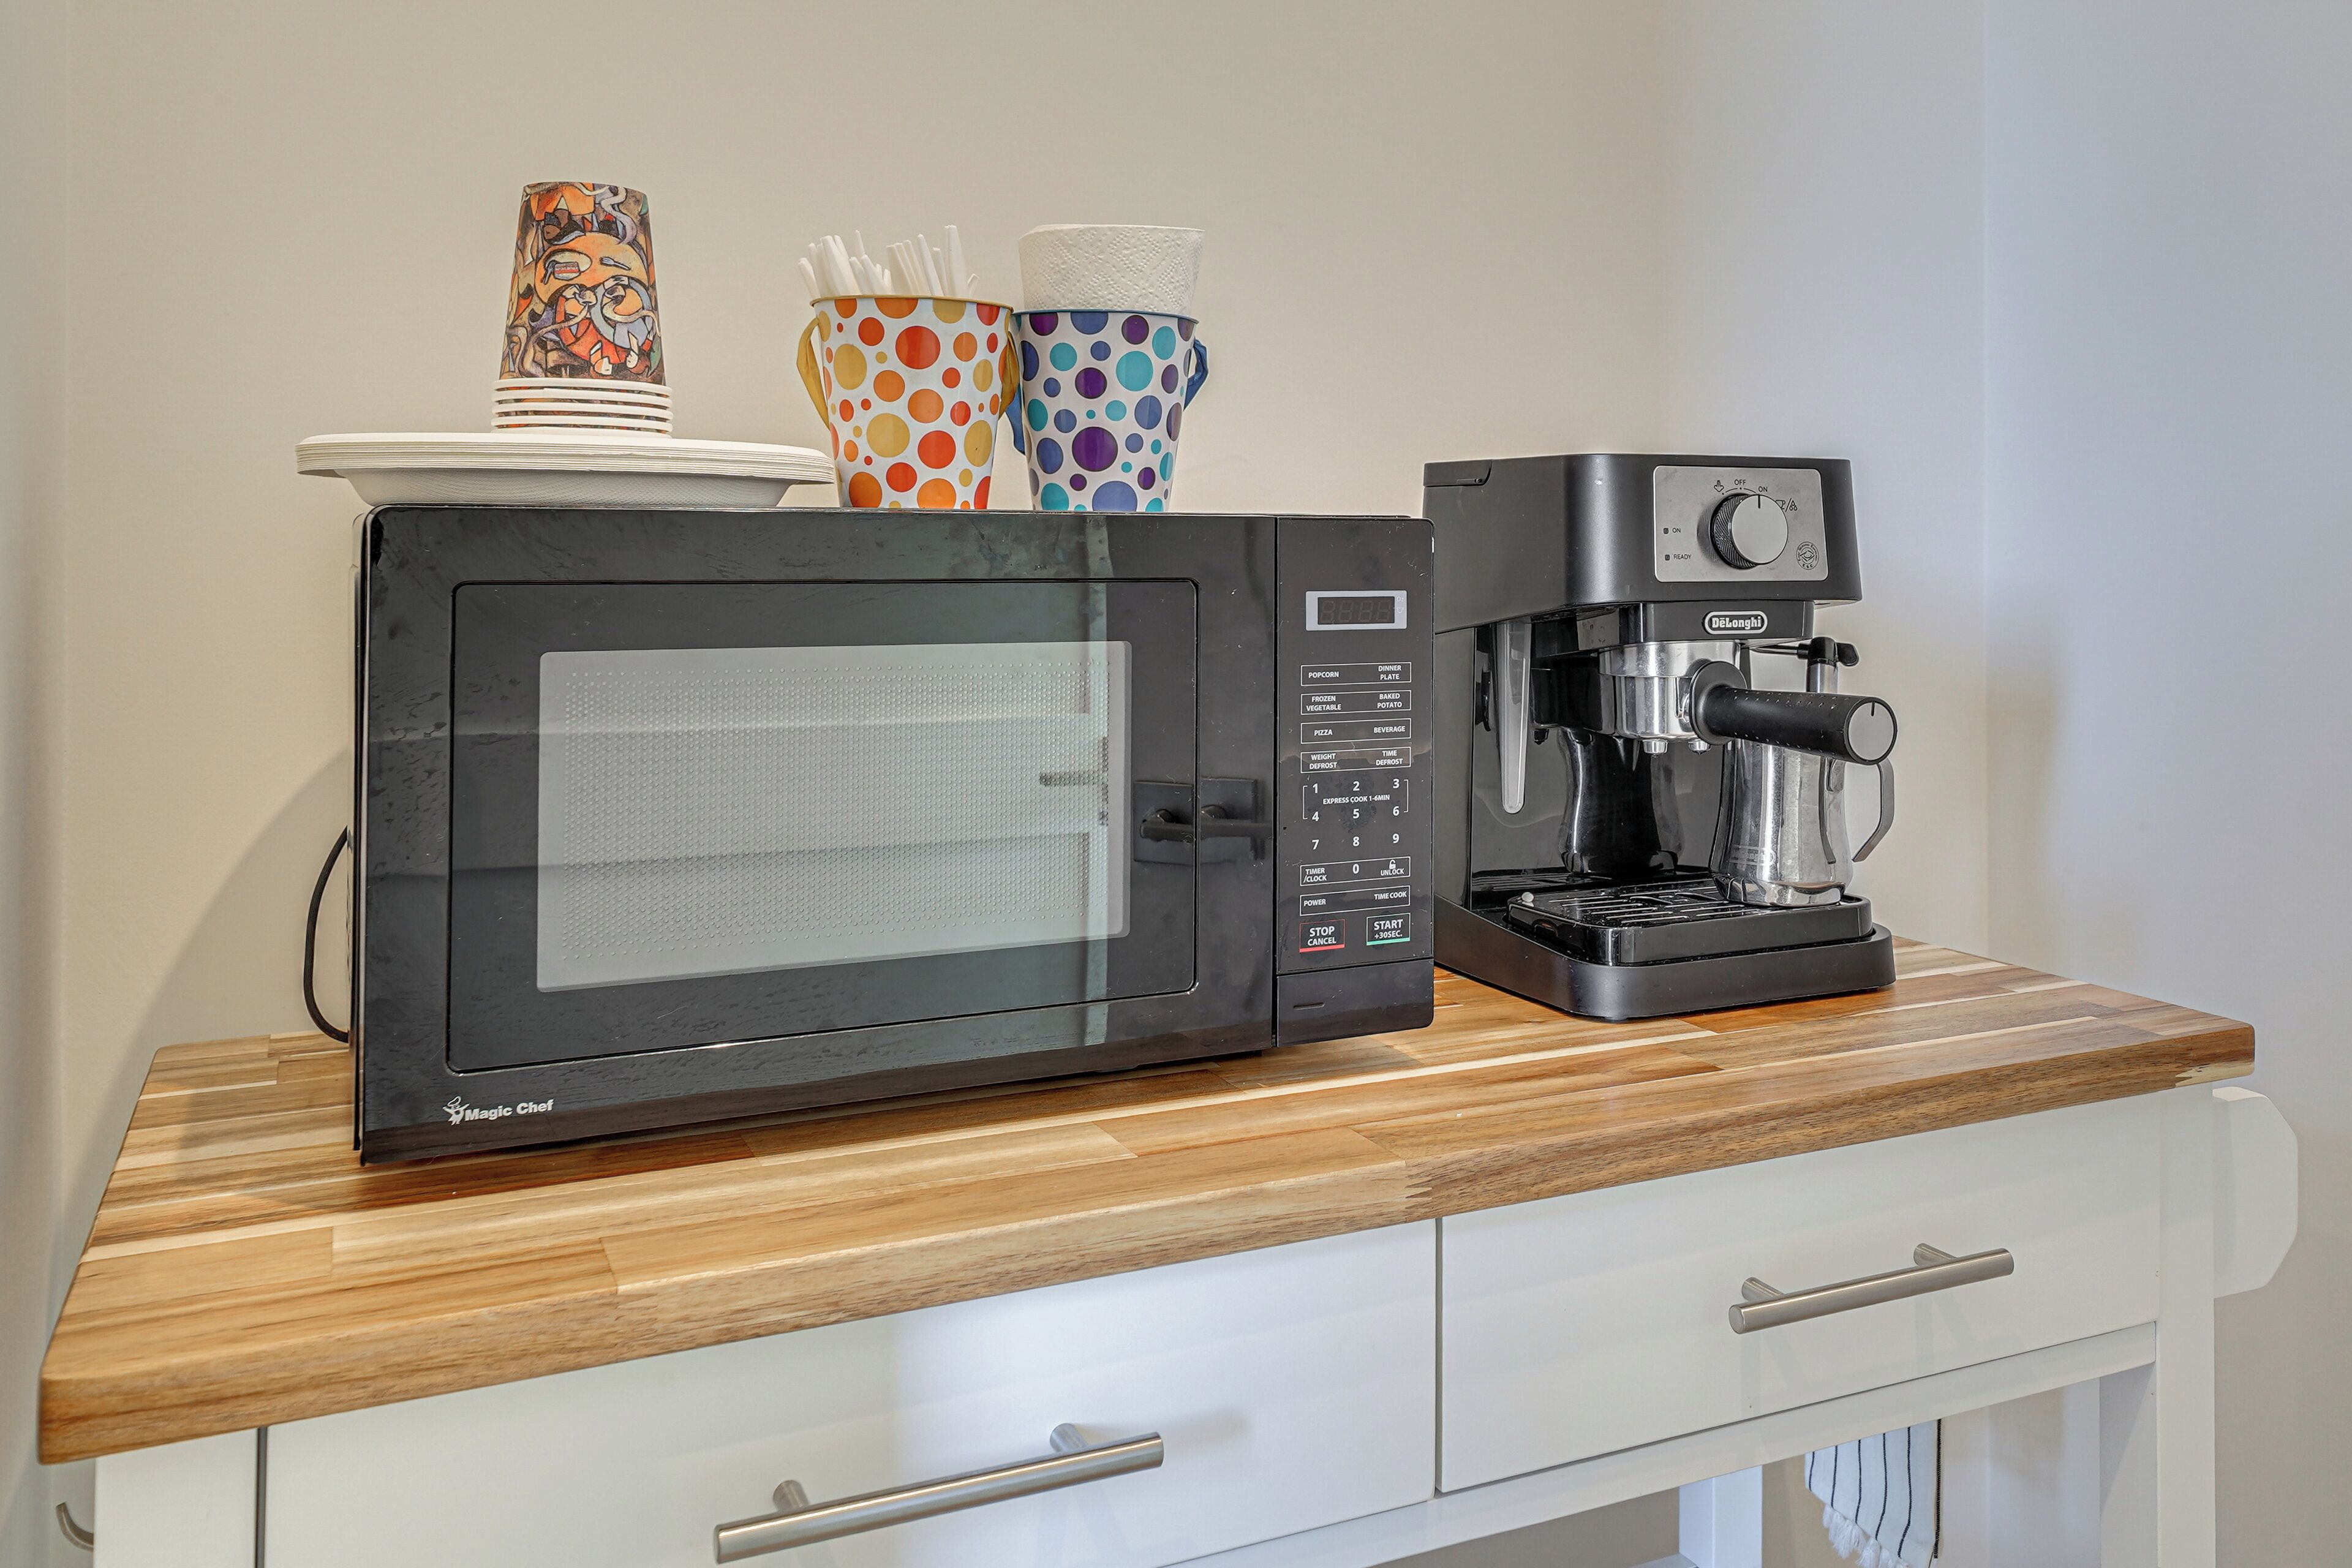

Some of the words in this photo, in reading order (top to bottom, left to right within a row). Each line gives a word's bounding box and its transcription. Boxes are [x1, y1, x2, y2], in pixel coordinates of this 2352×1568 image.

[1309, 761, 1338, 770] DEFROST
[1375, 758, 1403, 766] DEFROST
[1312, 783, 1319, 794] 1
[1352, 781, 1360, 791] 2
[1393, 778, 1400, 789] 3
[1352, 808, 1360, 819] 5
[1393, 805, 1400, 816] 6
[1311, 811, 1319, 822] 4
[1352, 836, 1360, 847] 8
[1392, 833, 1400, 844] 9
[1312, 839, 1319, 850] 7
[1352, 863, 1360, 874] 0
[1380, 868, 1405, 876] UNLOCK
[1389, 891, 1408, 899] COOK
[1303, 899, 1326, 907] POWER
[1374, 919, 1403, 930] START
[1310, 925, 1335, 937] STOP
[1374, 930, 1403, 939] +30SEC.
[1307, 936, 1337, 946] CANCEL
[464, 1105, 513, 1121] Magic
[516, 1099, 554, 1115] Chef
